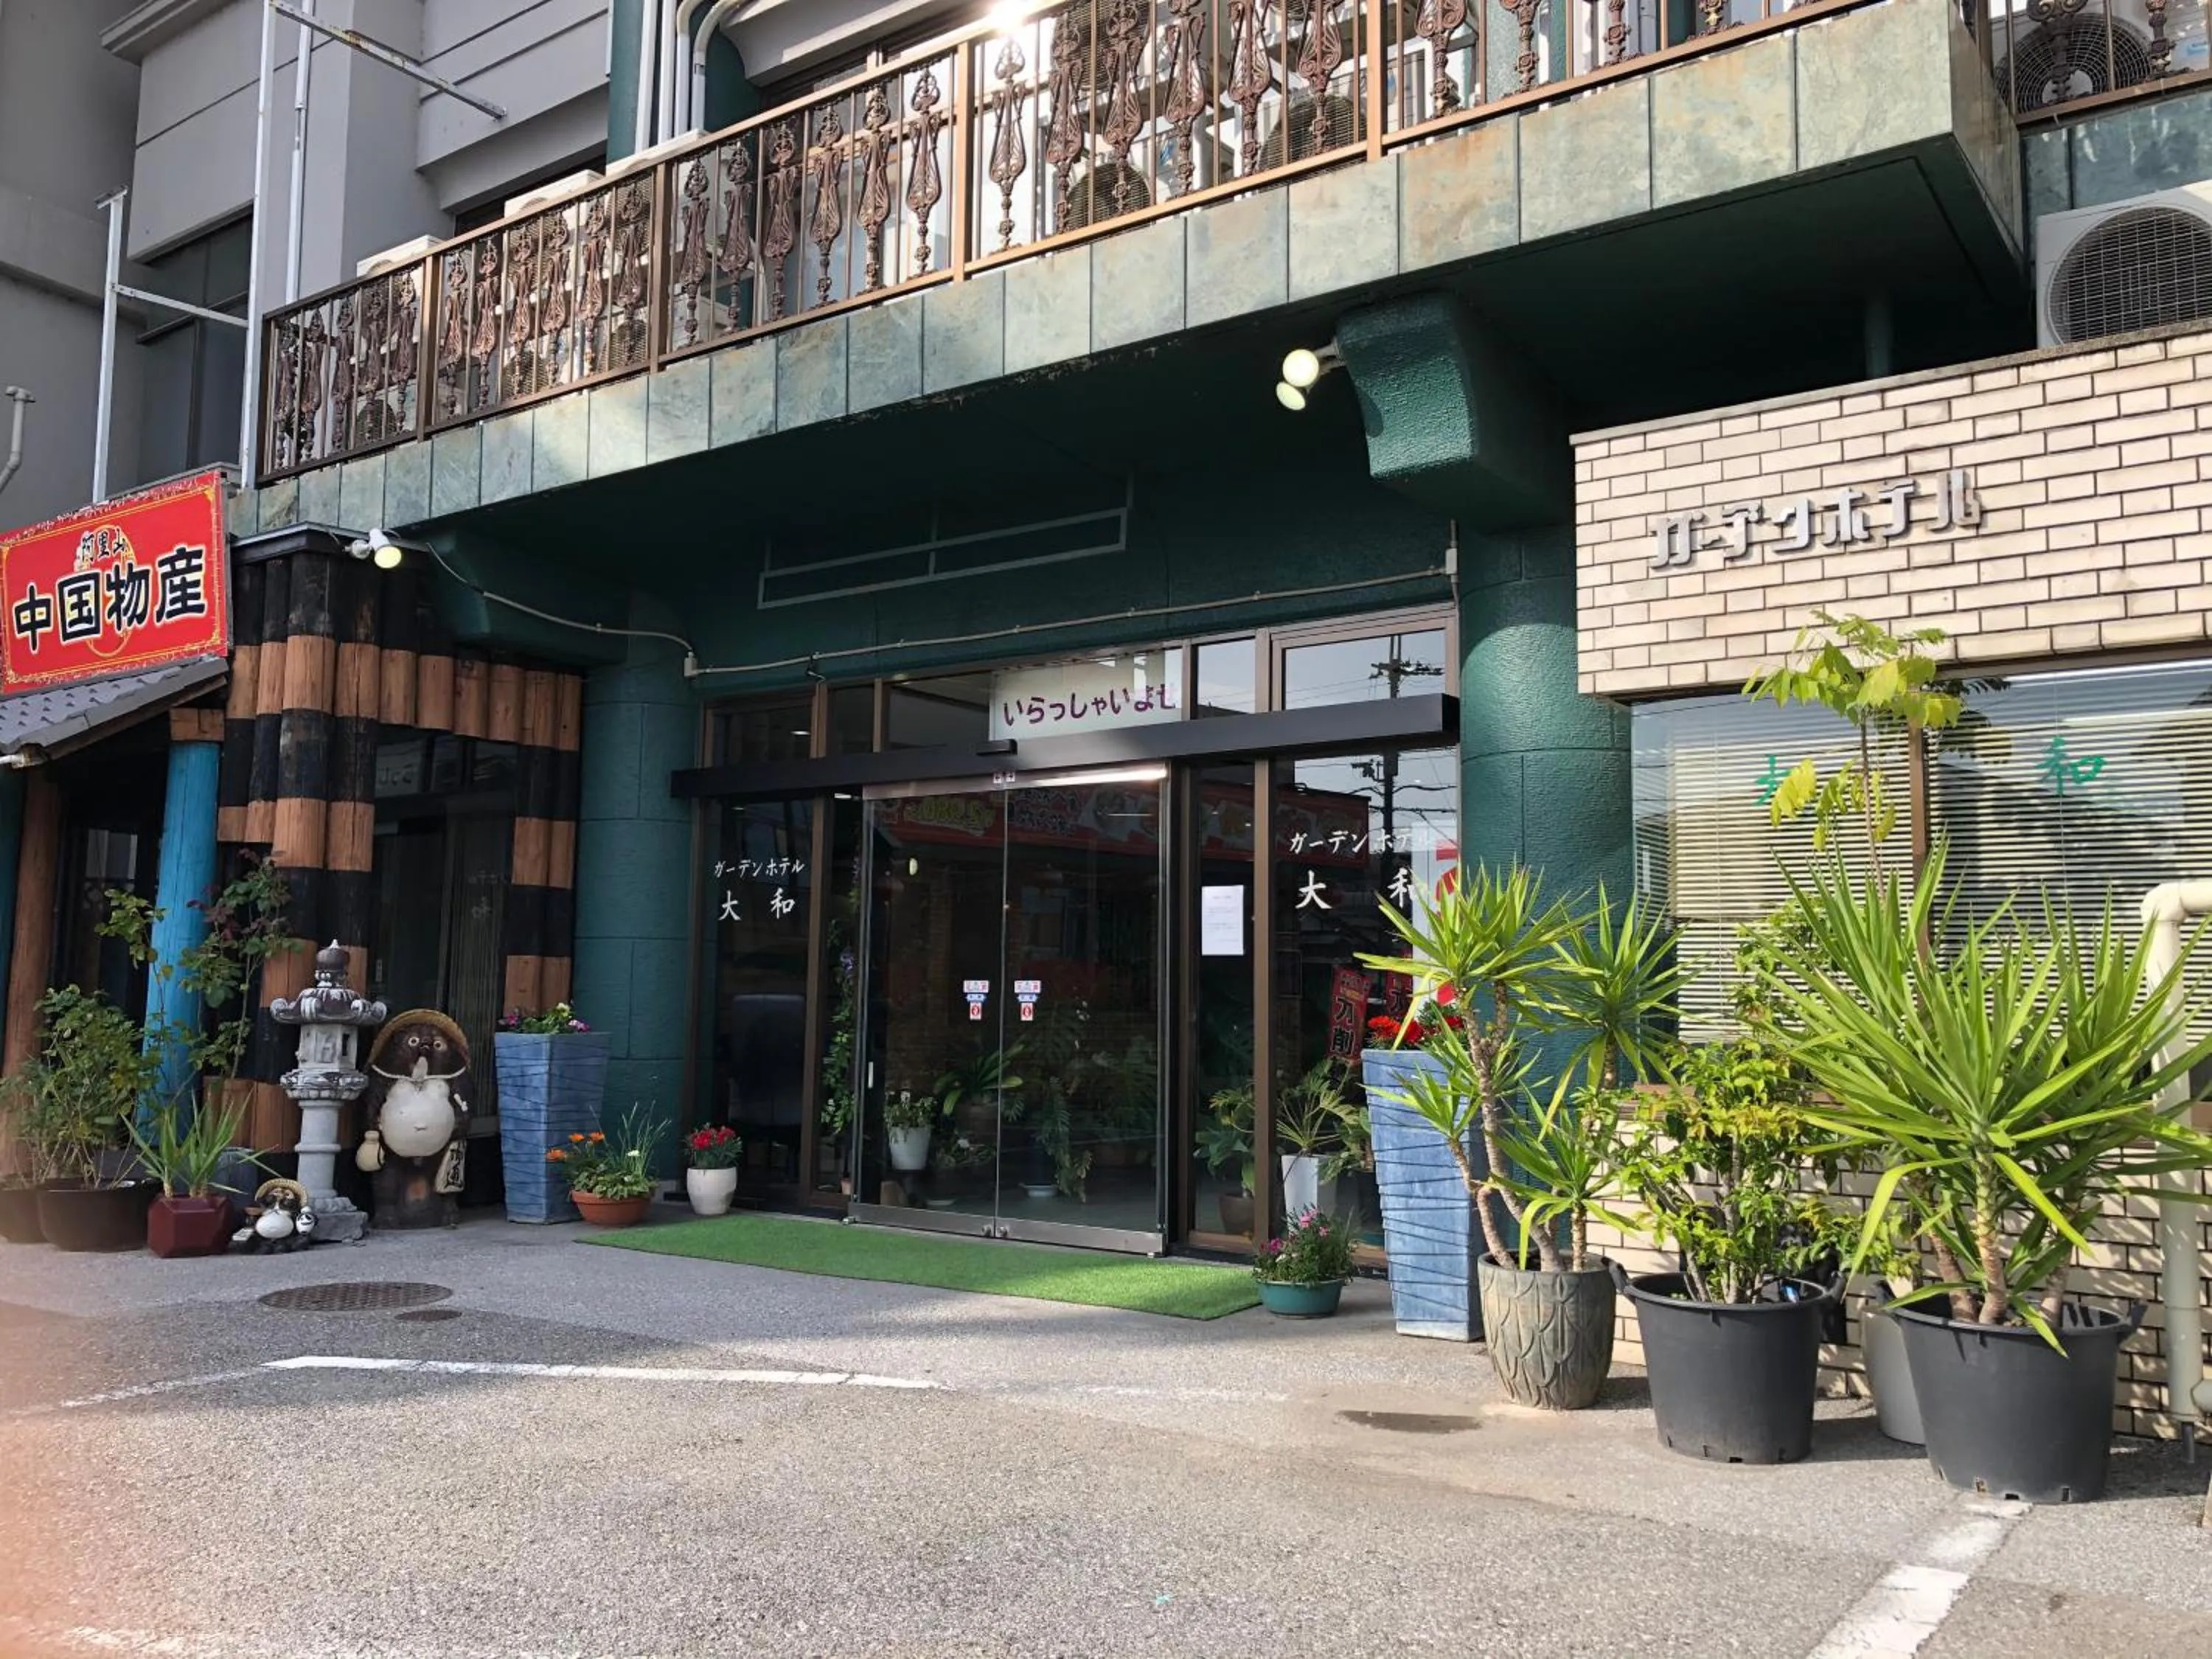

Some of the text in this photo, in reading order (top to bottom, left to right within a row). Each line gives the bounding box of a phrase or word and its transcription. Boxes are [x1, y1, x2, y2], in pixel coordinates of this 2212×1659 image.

[1649, 468, 1983, 571] ガーデンホテル
[13, 546, 207, 652] 中国物産
[2034, 736, 2109, 796] 和
[1290, 828, 1414, 855] ガーデンホテ
[714, 858, 804, 877] ガーデンホテル
[718, 887, 796, 921] 大 和
[1295, 869, 1332, 909] 大
